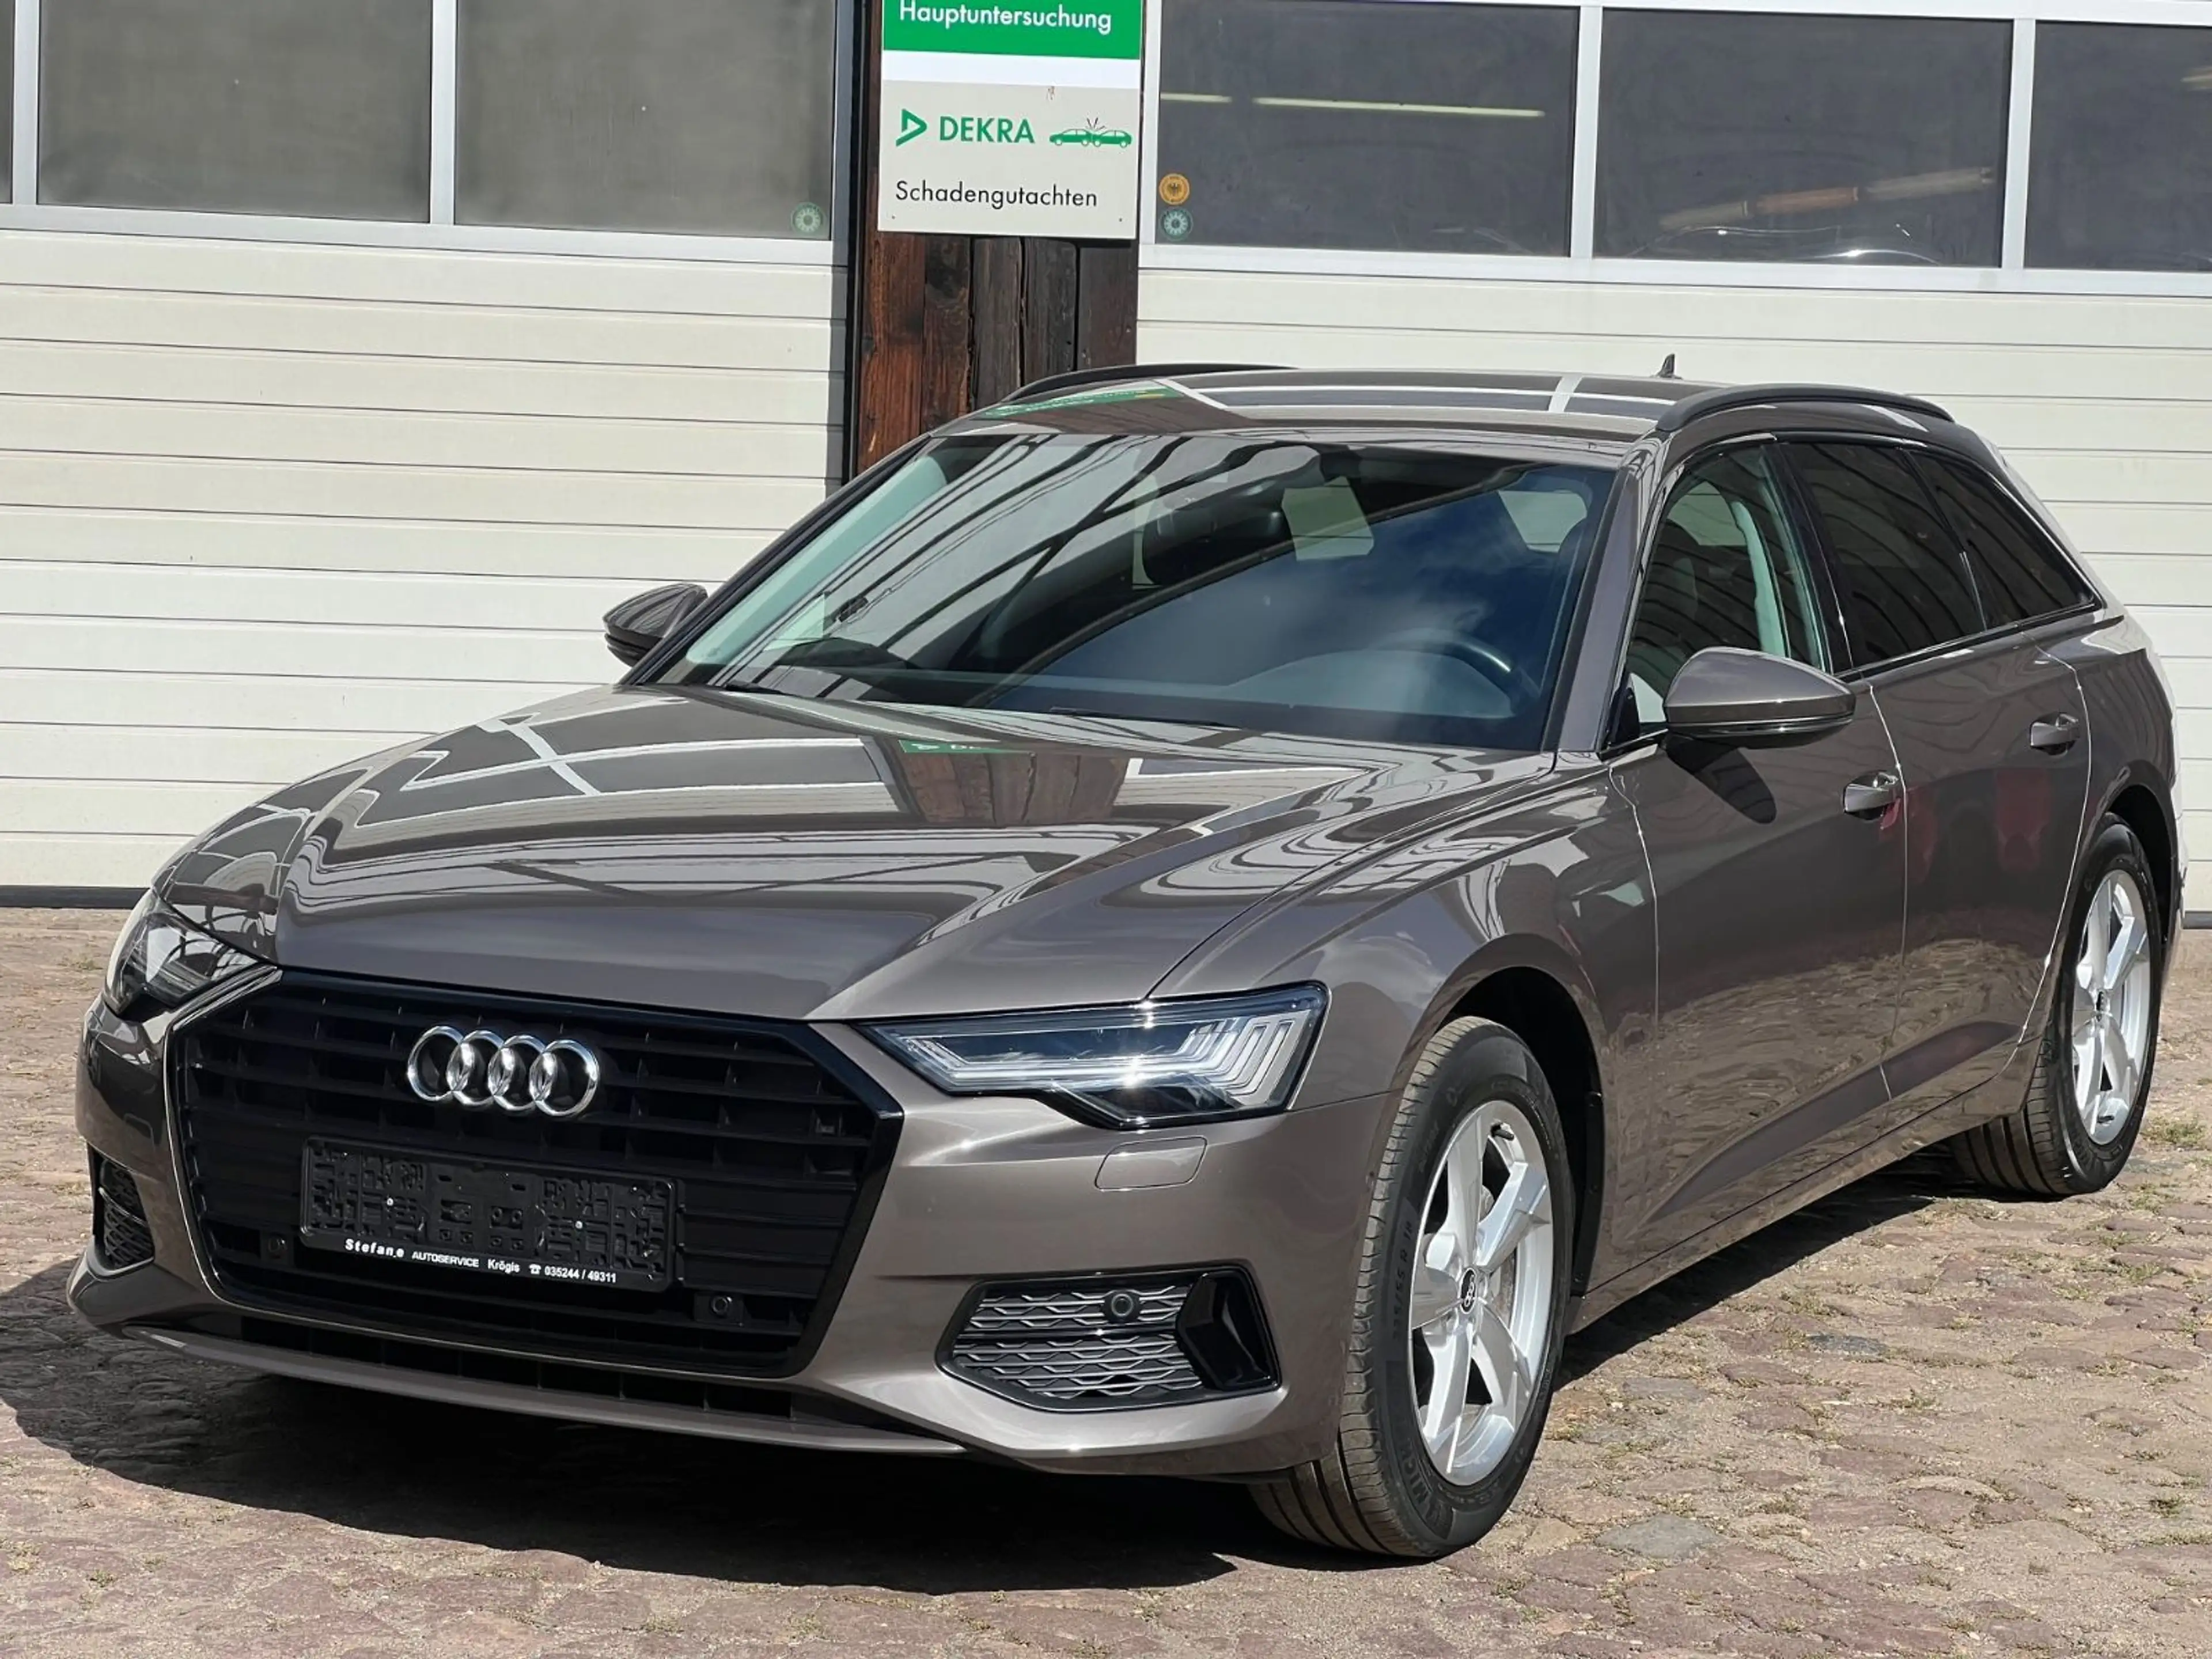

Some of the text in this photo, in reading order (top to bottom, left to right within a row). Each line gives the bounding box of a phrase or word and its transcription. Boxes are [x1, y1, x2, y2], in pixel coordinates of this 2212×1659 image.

[899, 0, 1112, 35] Hauptuntersuchung
[939, 116, 1036, 144] DEKRA
[895, 180, 1097, 210] Schadengutachten
[411, 1251, 480, 1268] AUTOSERVICE
[544, 1265, 579, 1279] 035244
[588, 1270, 616, 1283] 49311
